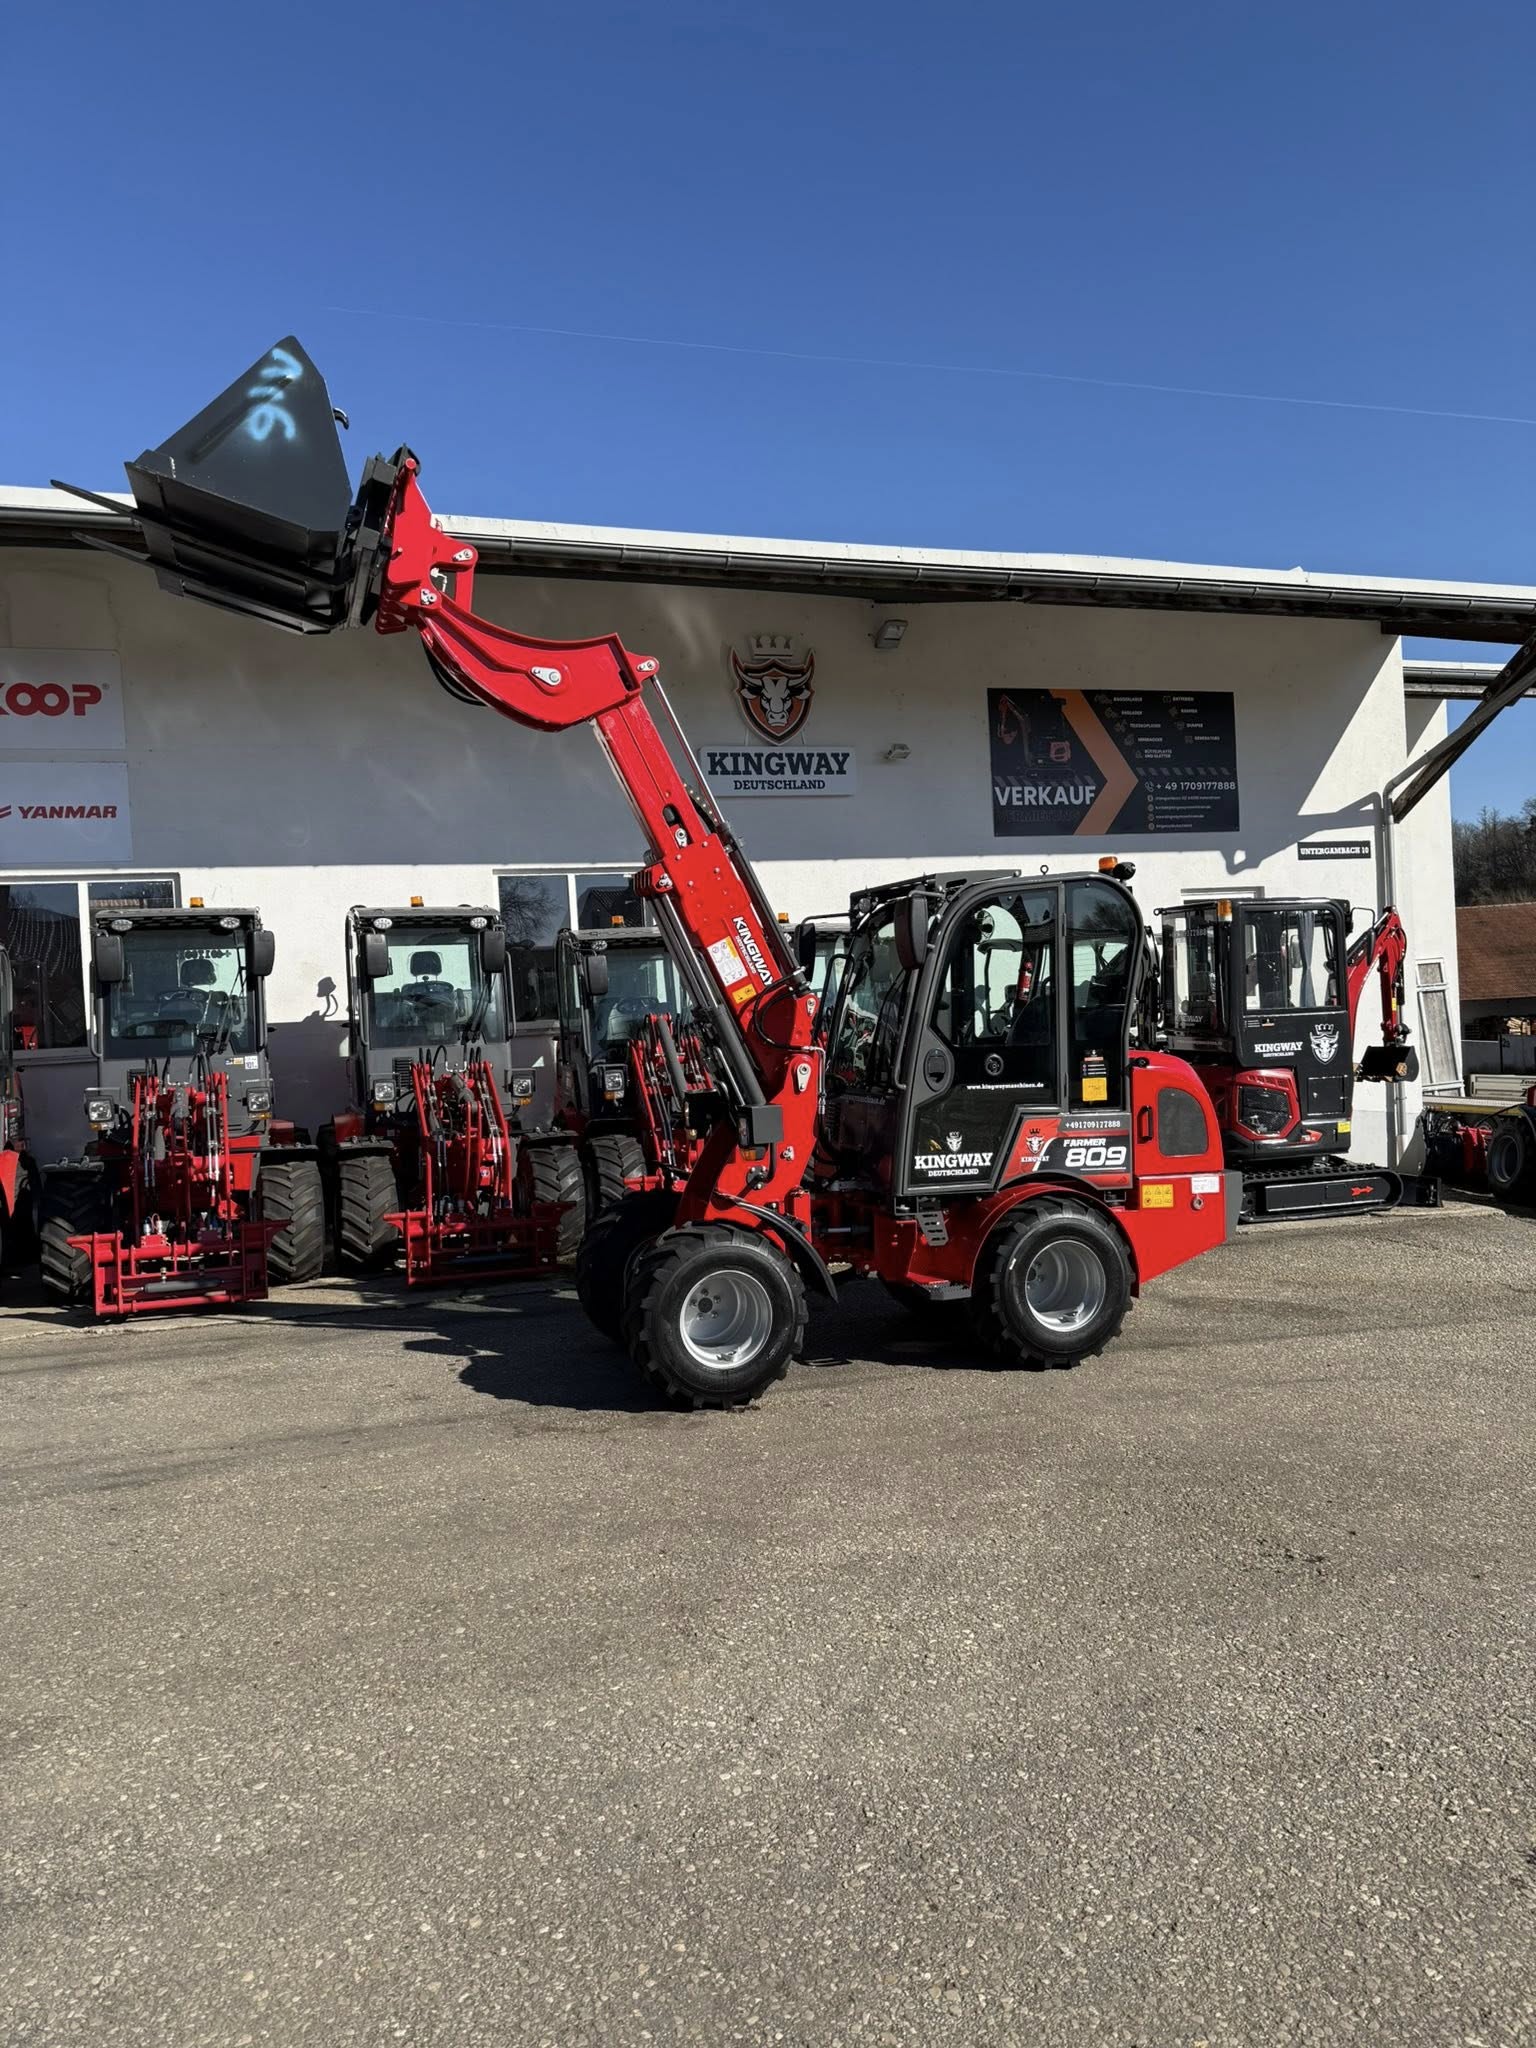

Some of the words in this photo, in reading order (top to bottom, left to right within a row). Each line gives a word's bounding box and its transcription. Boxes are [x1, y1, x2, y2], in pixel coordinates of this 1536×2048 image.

[707, 752, 850, 776] KINGWAY
[734, 780, 826, 790] DEUTSCHLAND
[1165, 782, 1177, 790] 49
[1180, 782, 1236, 790] 1709177888
[994, 785, 1096, 806] VERKAUF
[18, 805, 117, 819] YANMAR
[732, 916, 774, 986] KINGWAY
[1254, 1042, 1303, 1053] KINGWAY
[1065, 1120, 1120, 1128] +491709177888
[1063, 1138, 1106, 1147] FARMER
[914, 1152, 993, 1169] KINGWAY
[1065, 1146, 1127, 1167] 809
[928, 1168, 979, 1177] DEUTSCHLAND
